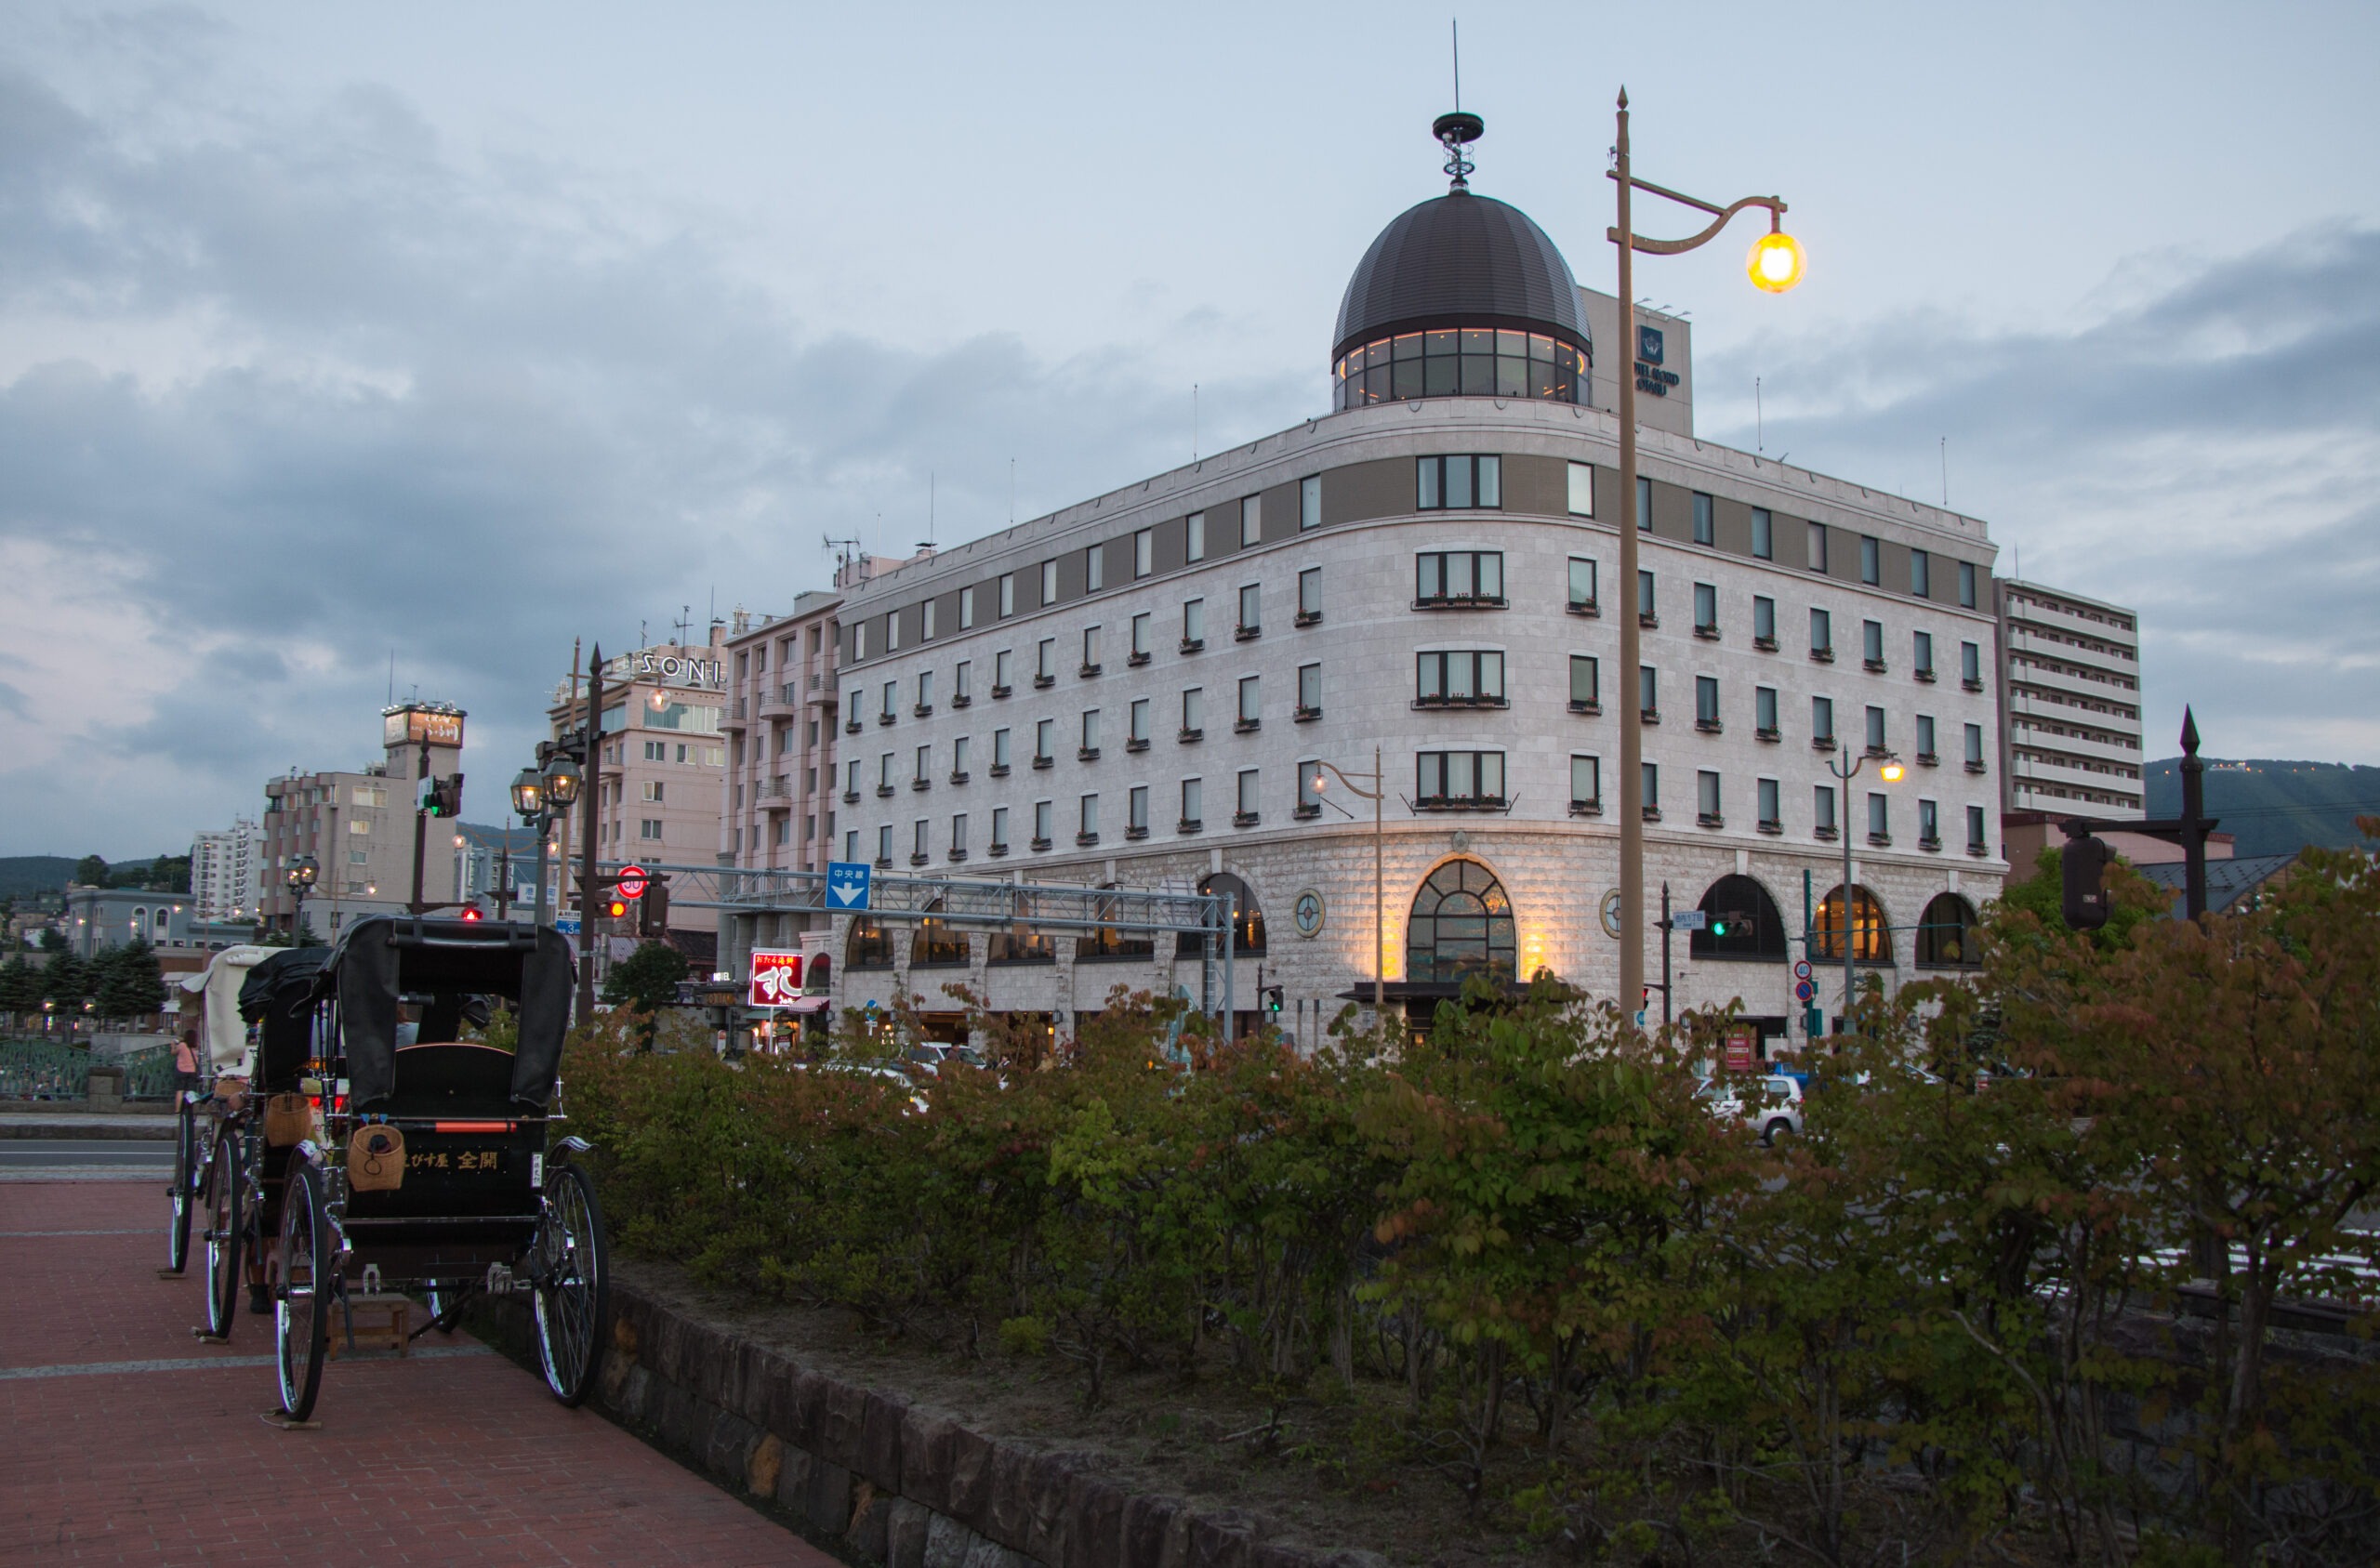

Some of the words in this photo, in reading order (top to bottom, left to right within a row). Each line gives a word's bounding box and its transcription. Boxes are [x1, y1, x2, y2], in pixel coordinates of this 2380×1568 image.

[641, 652, 727, 683] SONI
[834, 869, 864, 879] 中央線
[1798, 966, 1808, 975] 40
[713, 972, 730, 982] HOTEL
[755, 966, 802, 1000] すし
